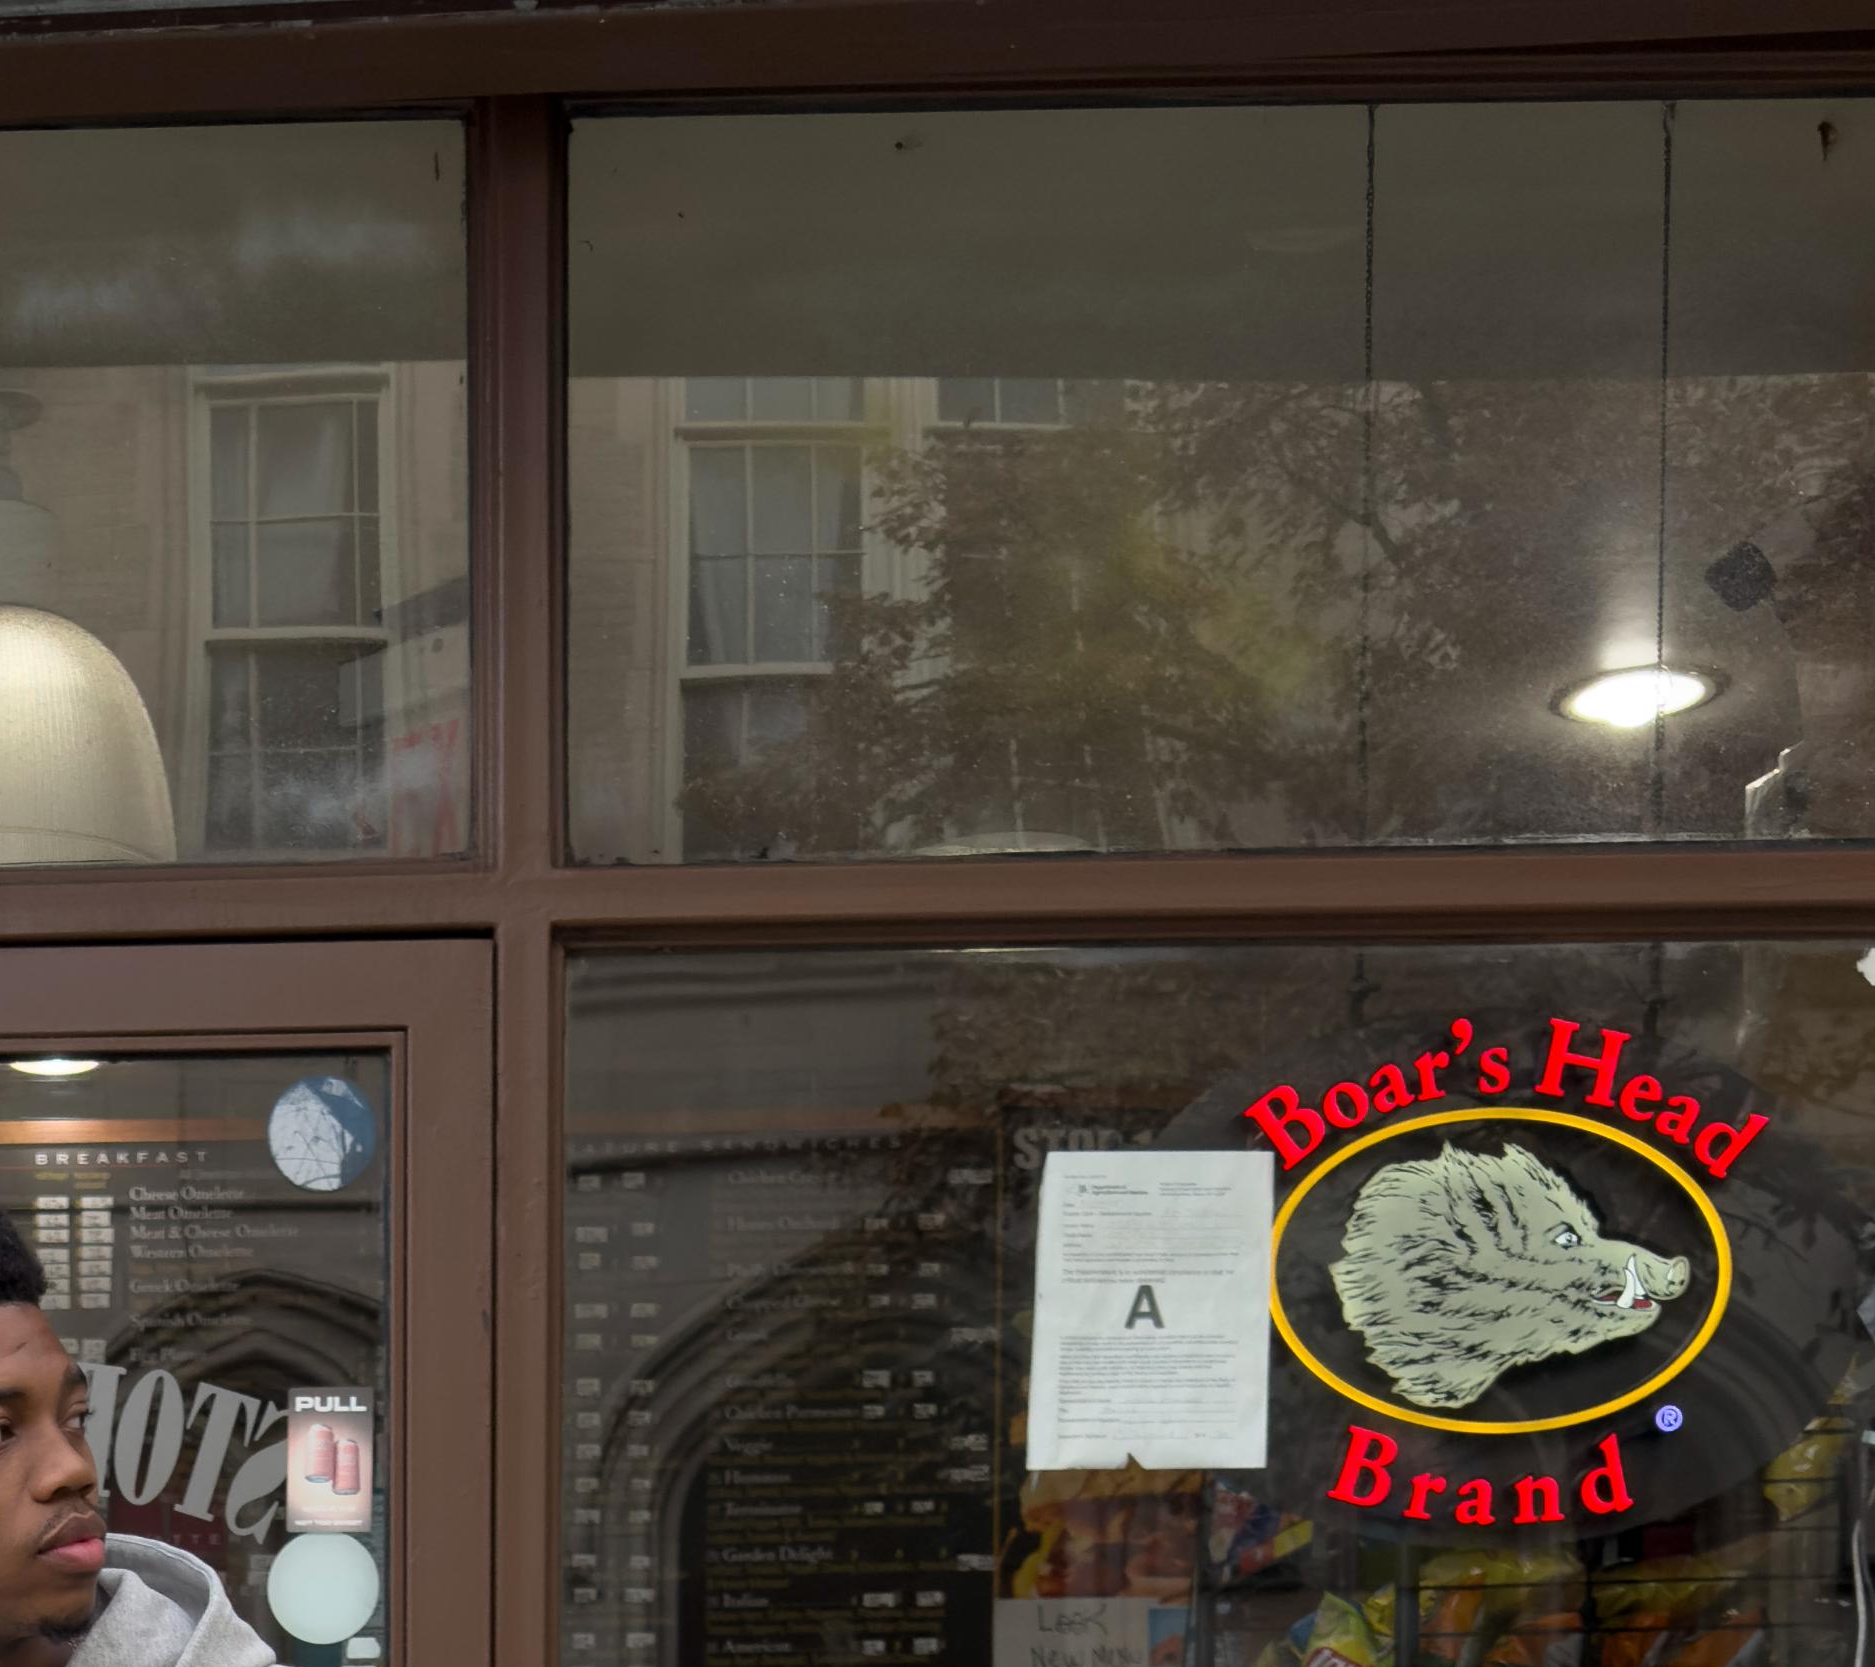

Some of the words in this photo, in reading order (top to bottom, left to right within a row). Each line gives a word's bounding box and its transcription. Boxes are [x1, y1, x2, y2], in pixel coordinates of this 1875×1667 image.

[1245, 1017, 1512, 1171] Boar's
[1534, 1017, 1770, 1179] Head
[34, 1150, 209, 1166] BREAKFAST
[1124, 1284, 1165, 1330] A
[293, 1395, 368, 1413] PULL
[1327, 1425, 1635, 1527] Brand
